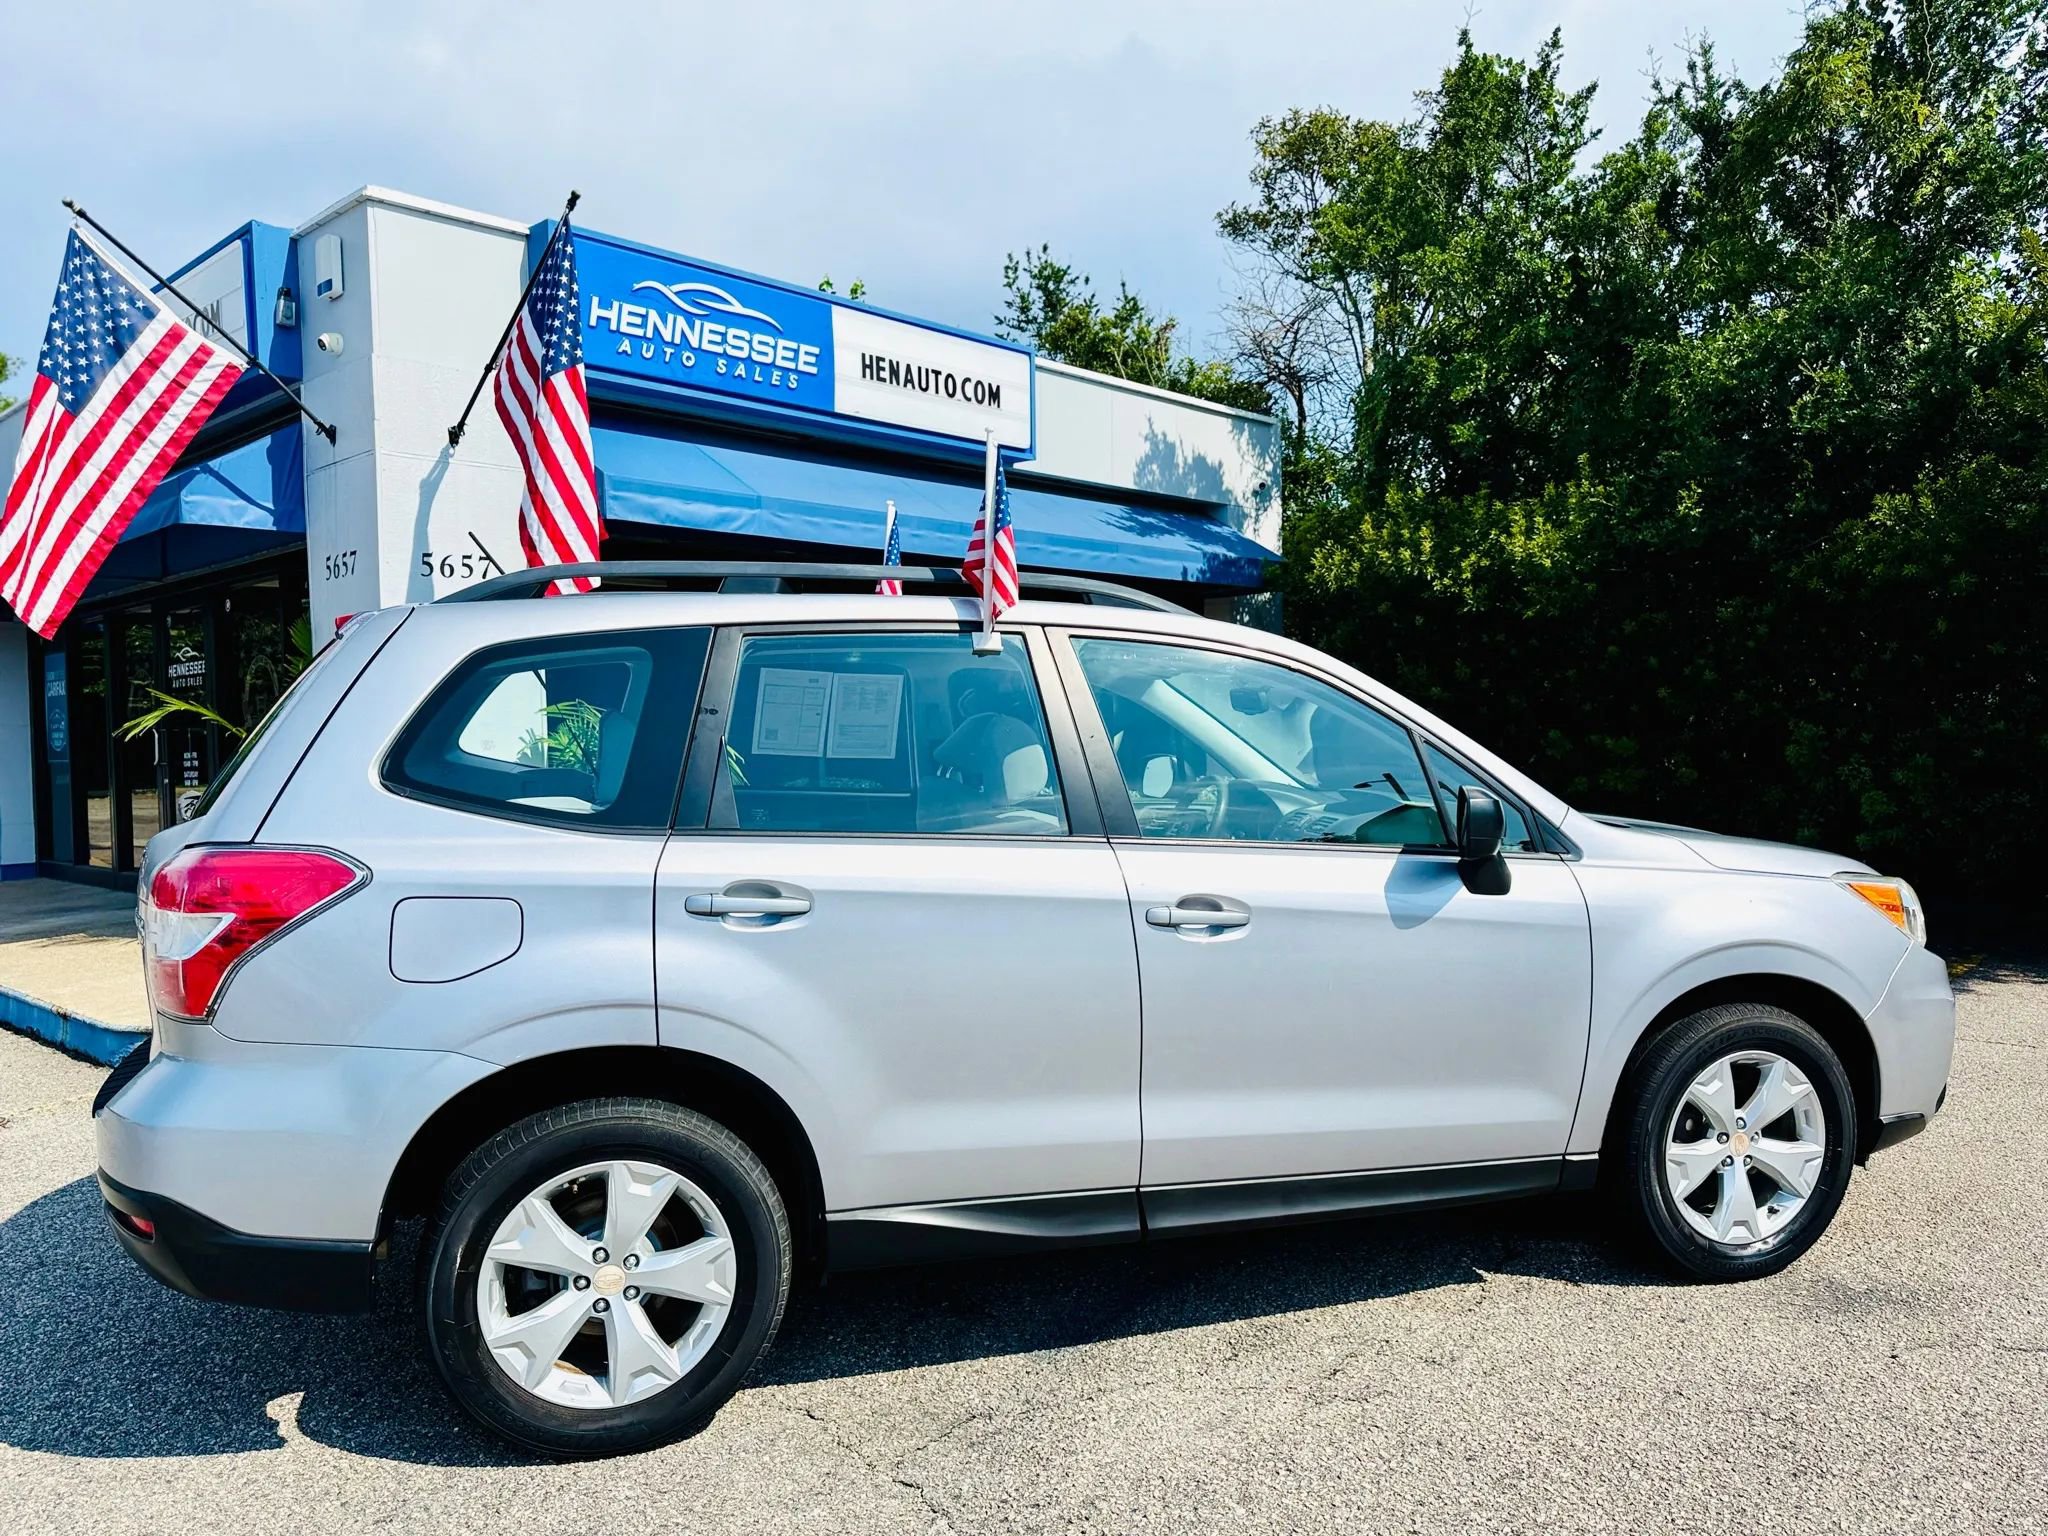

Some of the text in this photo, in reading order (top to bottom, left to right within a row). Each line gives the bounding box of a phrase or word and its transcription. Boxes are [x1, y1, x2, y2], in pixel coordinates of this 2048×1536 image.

[588, 294, 821, 376] HENNESSEE
[617, 337, 799, 390] AUTO SALES
[325, 550, 358, 581] 5657
[420, 551, 493, 580] 5657
[168, 660, 206, 678] HENNESSEE
